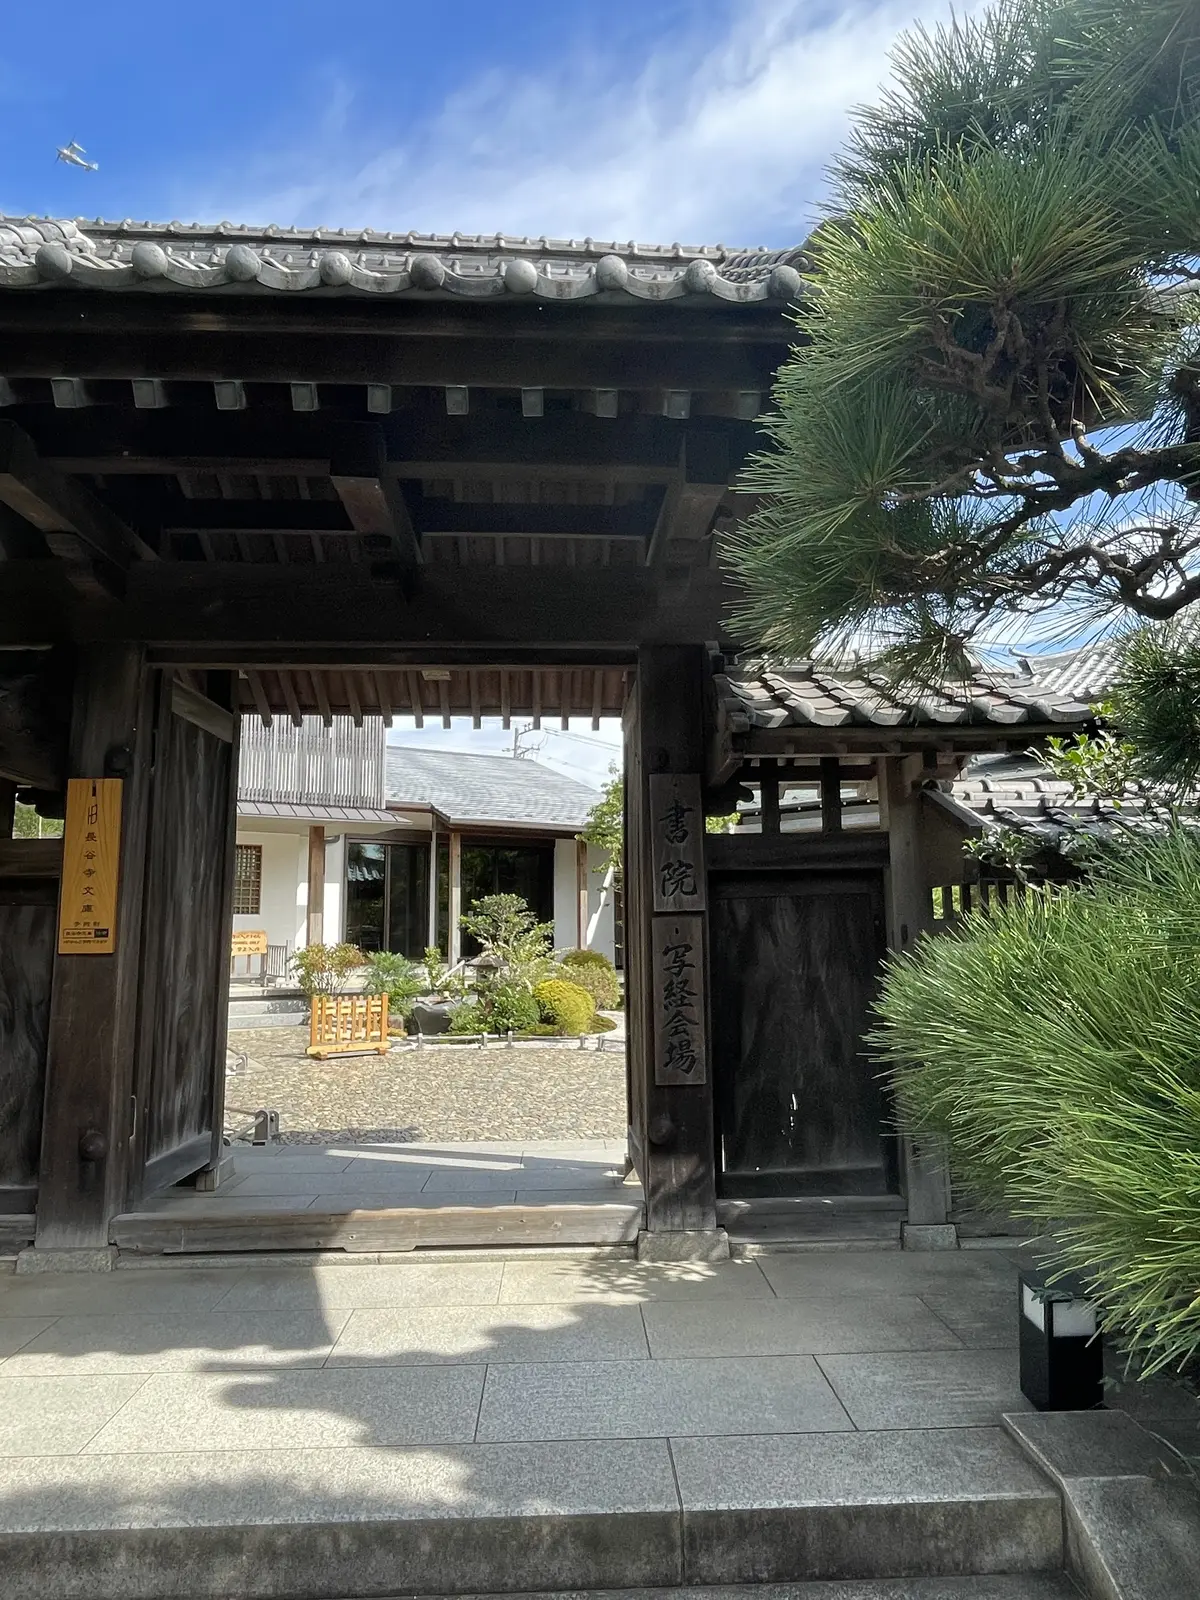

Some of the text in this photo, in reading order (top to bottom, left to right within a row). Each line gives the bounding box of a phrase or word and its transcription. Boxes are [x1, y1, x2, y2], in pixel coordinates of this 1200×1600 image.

[660, 799, 698, 897] 書院
[661, 943, 700, 1075] 写経会場
